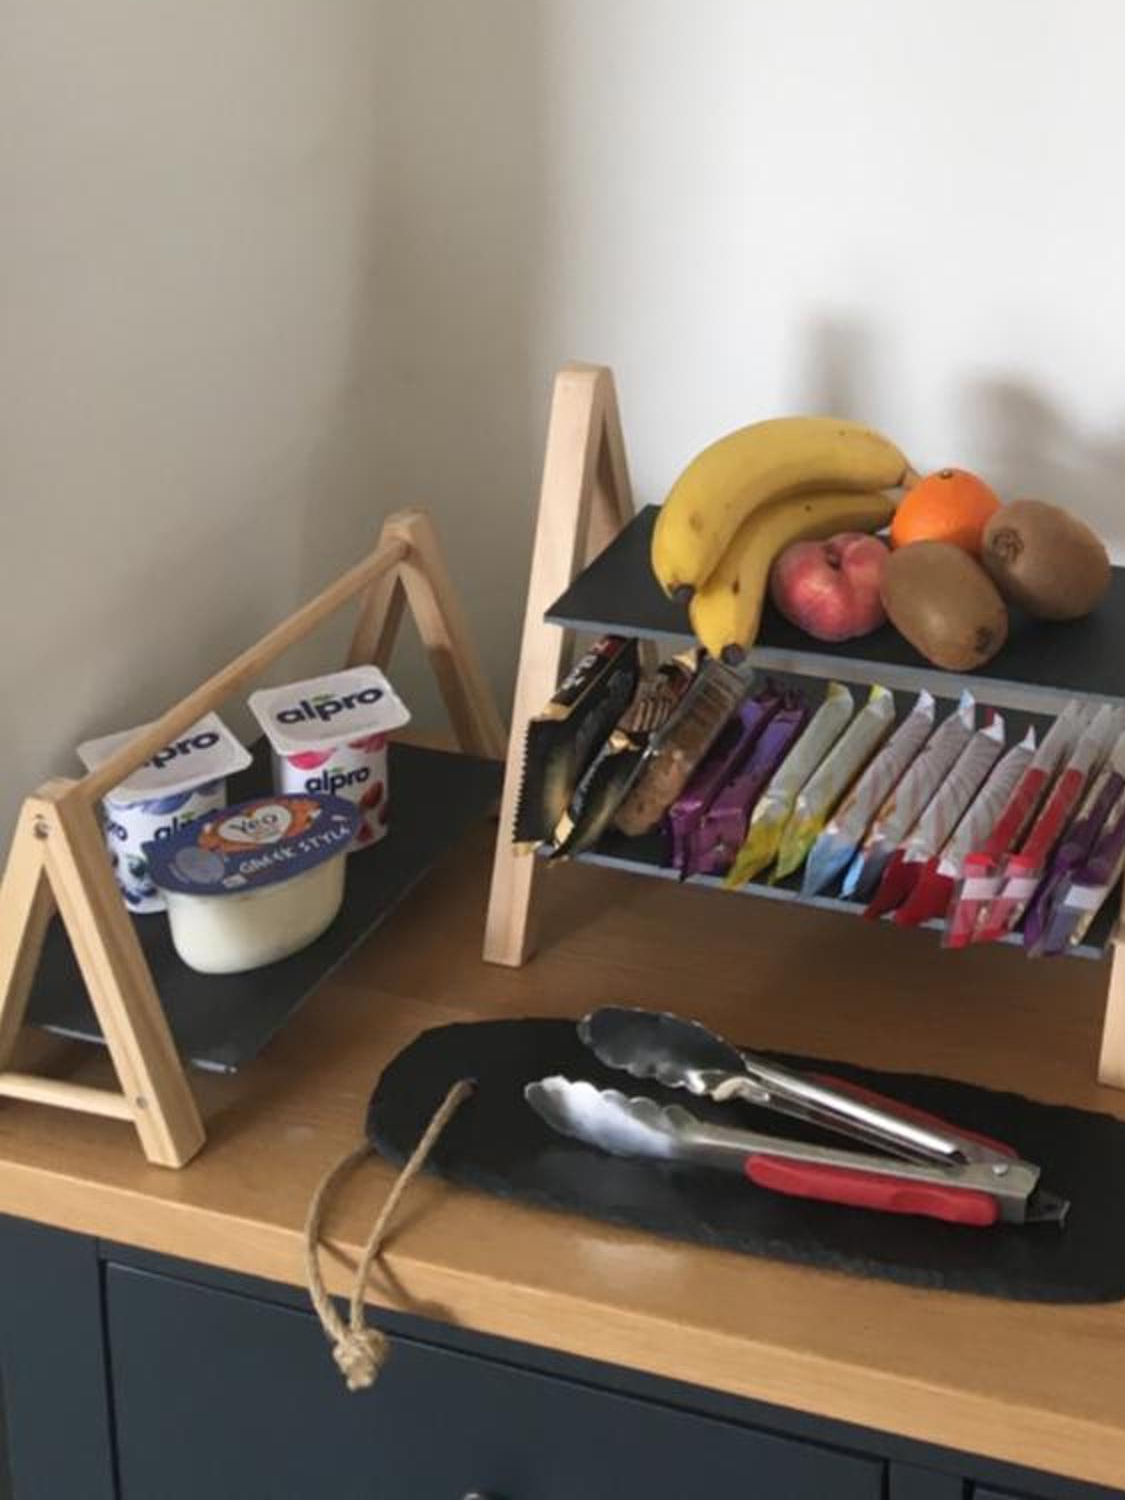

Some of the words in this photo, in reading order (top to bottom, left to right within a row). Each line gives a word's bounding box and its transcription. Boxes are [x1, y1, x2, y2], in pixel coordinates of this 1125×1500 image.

[276, 688, 384, 724] alpro
[143, 731, 220, 769] pro
[304, 766, 371, 796] alpro
